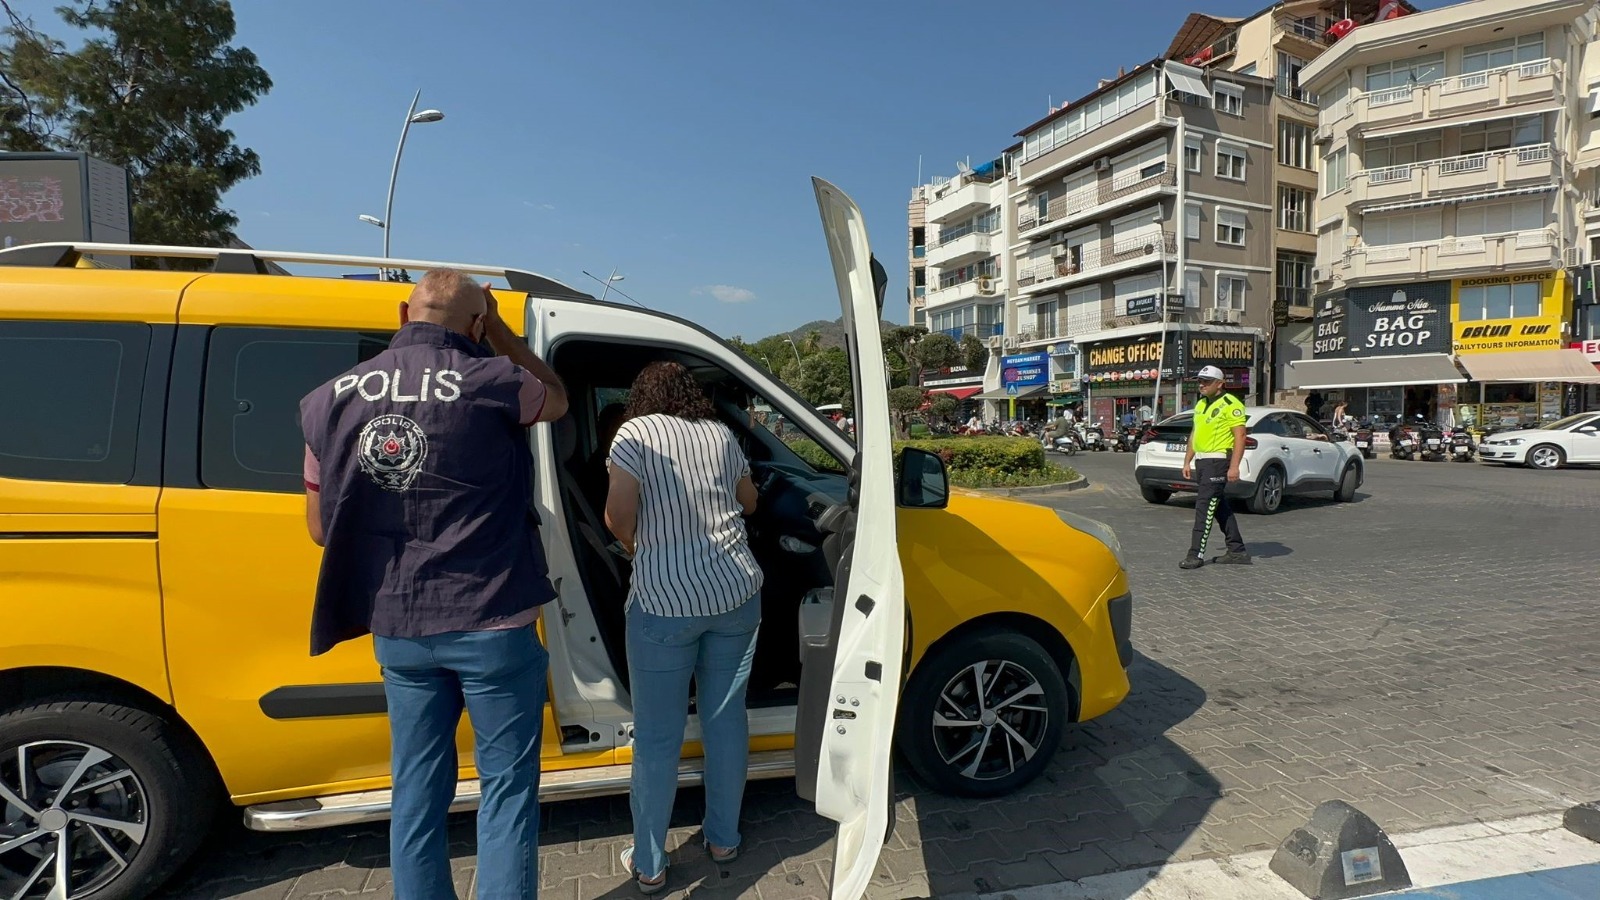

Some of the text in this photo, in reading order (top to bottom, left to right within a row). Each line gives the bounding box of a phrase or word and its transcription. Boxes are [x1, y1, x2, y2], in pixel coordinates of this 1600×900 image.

[1461, 272, 1552, 286] BOOKING OFFICE
[1368, 301, 1406, 313] Mamma
[1318, 320, 1340, 337] BAG
[1374, 315, 1424, 332] BAG
[1314, 337, 1344, 354] SHOP
[1365, 331, 1431, 348] SHOP
[1505, 339, 1560, 348] INFORMATION
[1089, 342, 1163, 366] CHANGE OFFICE
[1191, 339, 1252, 360] CHANGE OFFICE
